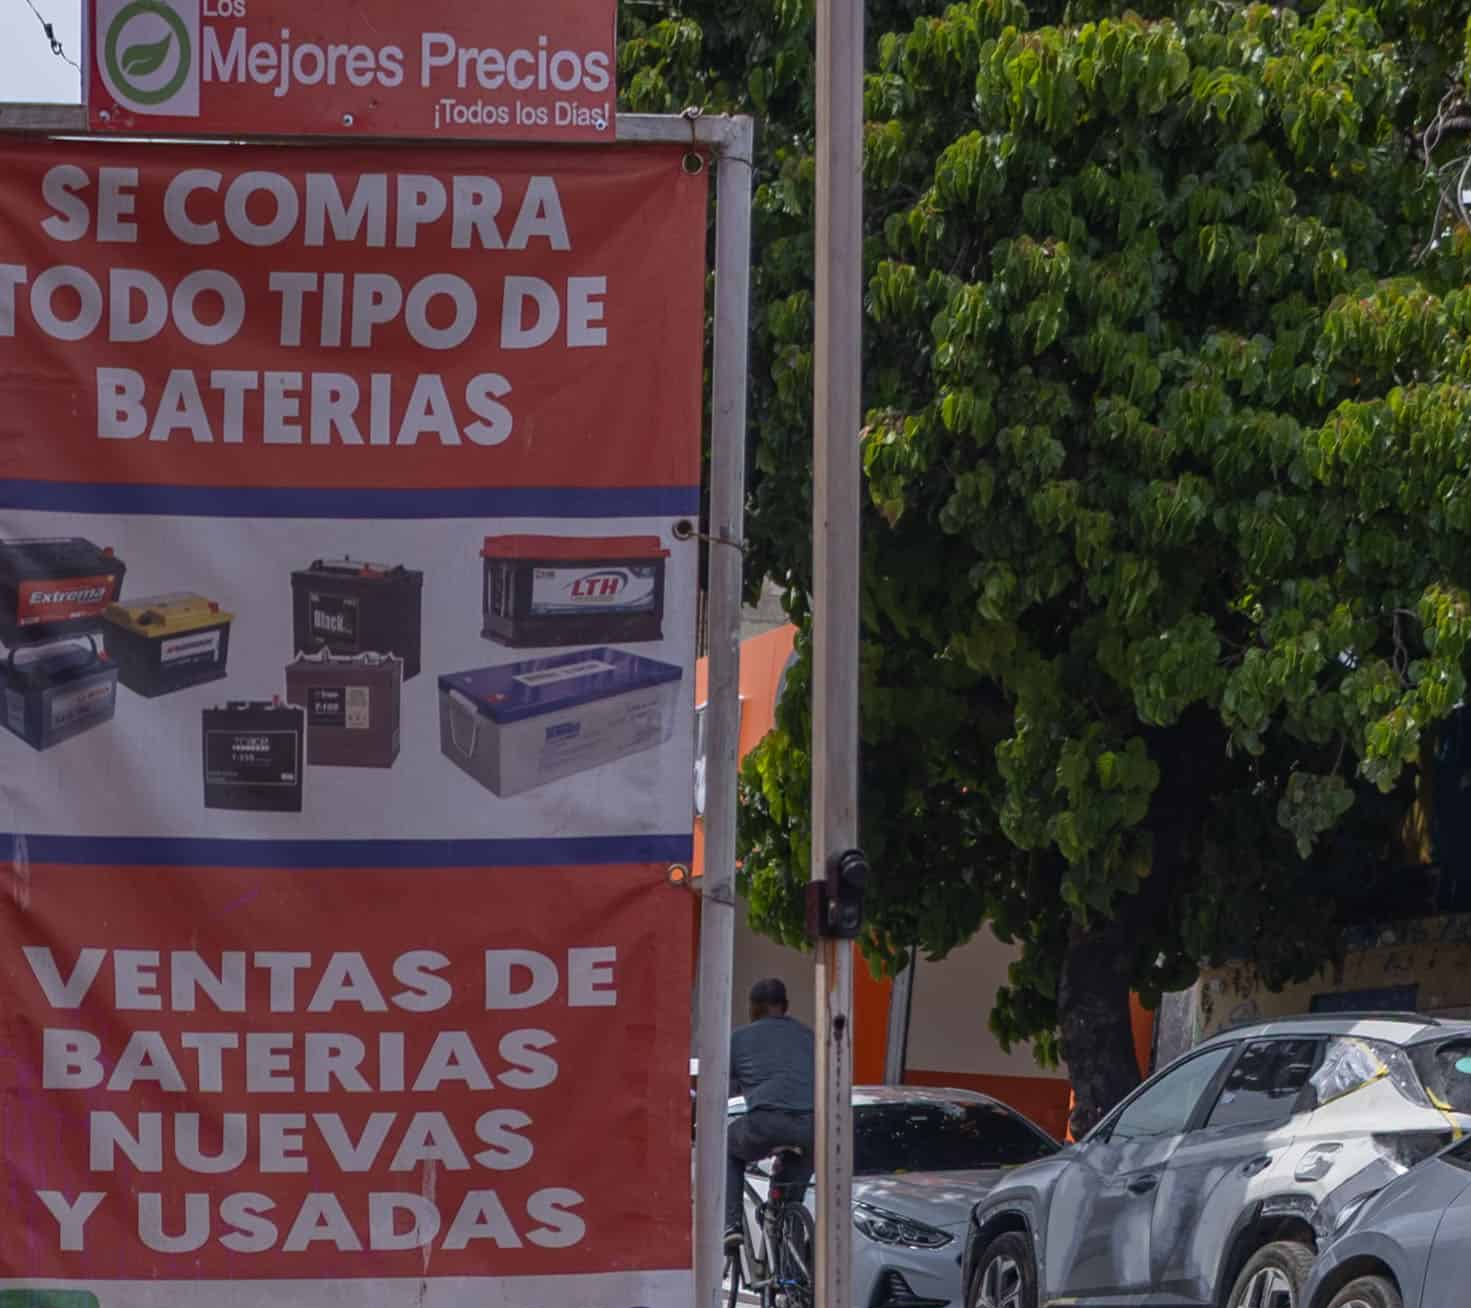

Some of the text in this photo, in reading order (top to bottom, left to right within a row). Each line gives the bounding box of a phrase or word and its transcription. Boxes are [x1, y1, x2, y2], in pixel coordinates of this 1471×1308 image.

[203, 27, 610, 96] Mejores Precios
[435, 98, 509, 128] ¡Todos
[516, 101, 547, 126] los
[40, 164, 572, 252] SE COMPRA
[269, 271, 477, 349] TIPO
[500, 276, 609, 350] DE
[97, 366, 514, 447] BATERIAS
[29, 587, 106, 605] Extrema
[571, 577, 619, 597] LTH
[314, 609, 344, 633] Black
[22, 945, 617, 1013] VENTAS DE
[42, 1027, 560, 1093] BATERIAS
[89, 1108, 534, 1174] NUEVAS
[36, 1187, 587, 1253] Y USADAS
